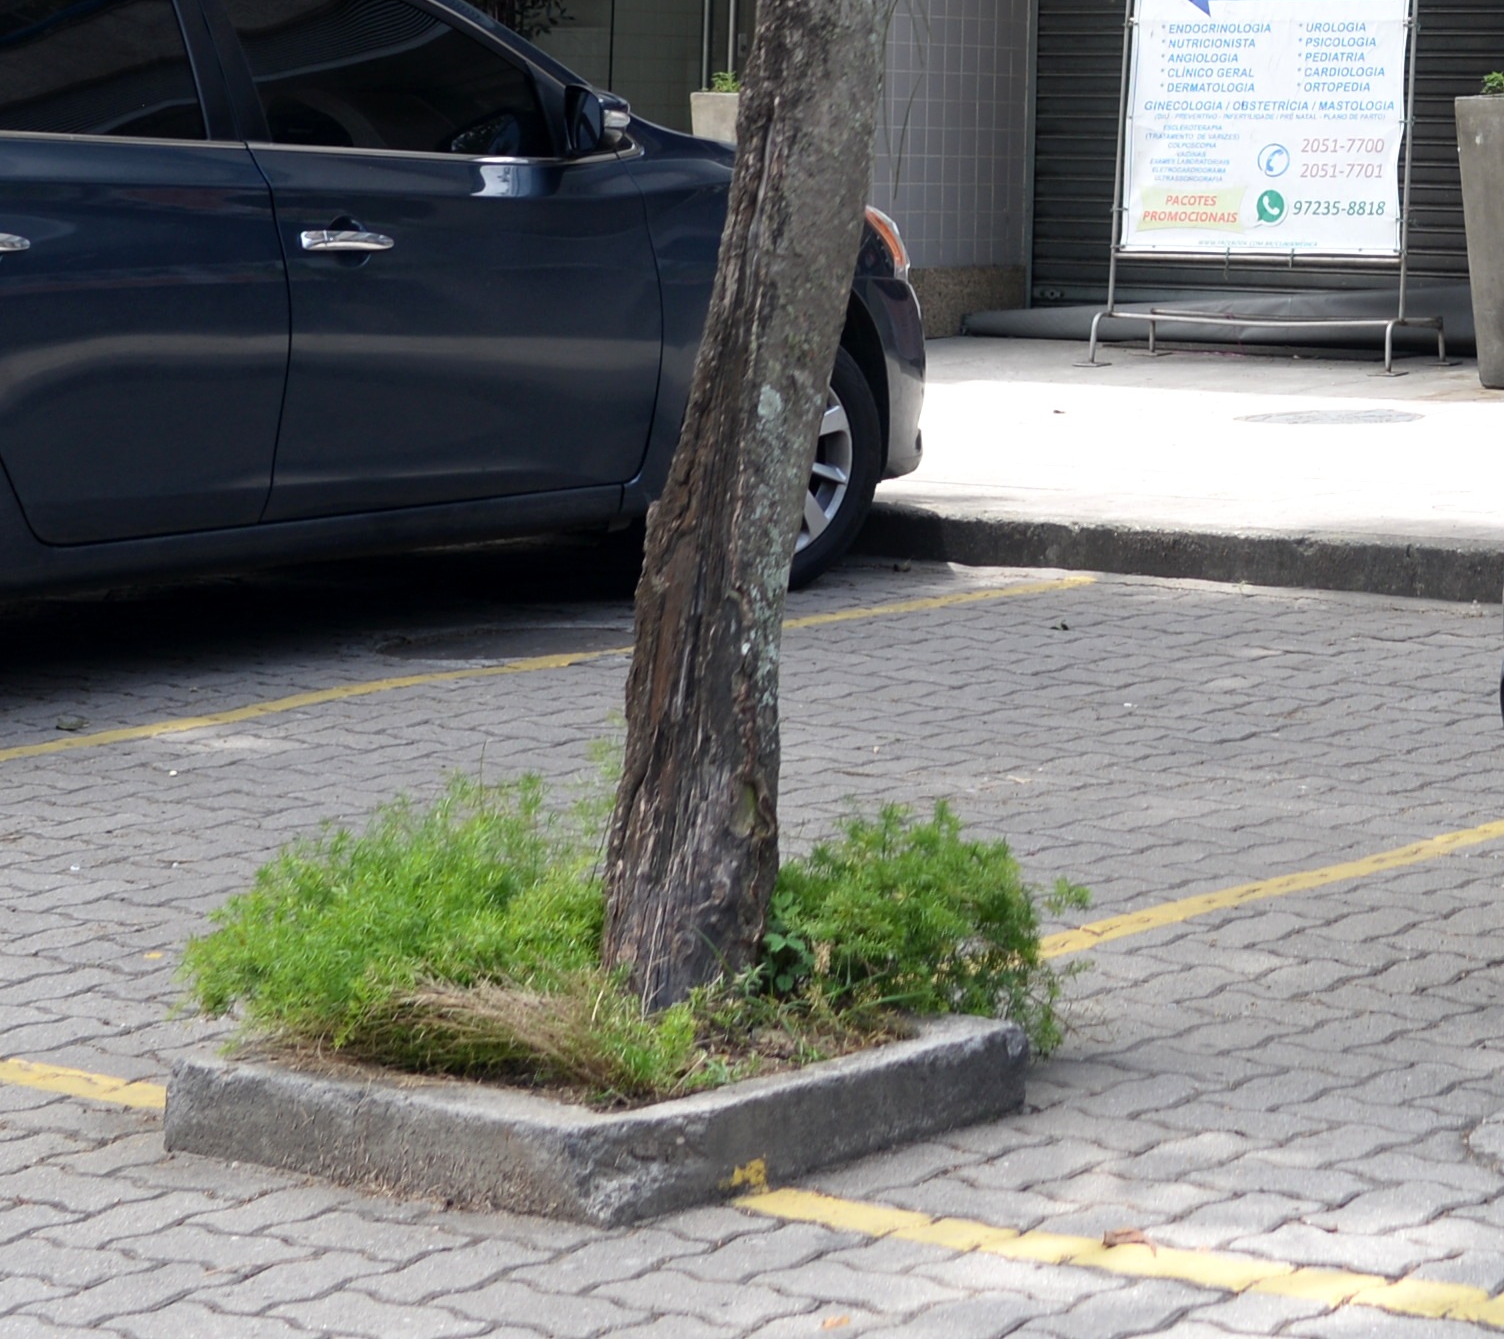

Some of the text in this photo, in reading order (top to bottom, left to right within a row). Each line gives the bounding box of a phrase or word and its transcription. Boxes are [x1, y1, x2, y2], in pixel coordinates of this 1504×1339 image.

[1168, 23, 1272, 34] ENDOCRINOLOGIA
[1305, 22, 1367, 33] UROLOGIA
[1168, 37, 1256, 48] NUTRICIONISTA
[1305, 37, 1377, 47] PSICOLOGIA
[1167, 53, 1239, 63] ANGIOLOGIA
[1304, 52, 1366, 62] PEDIATRIA
[1167, 66, 1255, 78] CLÍNICO GERAL
[1303, 66, 1386, 77] CARDIOLOGIA
[1166, 82, 1255, 93] DERMATOLOGIA
[1303, 82, 1371, 92] ORTOPEDIA
[1144, 98, 1395, 111] GINECOLOGIA OBSTETRÍCIA MASTOLOGIA
[1300, 138, 1385, 154] 2051-7700
[1299, 163, 1384, 179] 2051-7701
[1165, 195, 1218, 206] PACOTES
[1292, 200, 1386, 216] 97235-8818
[1142, 210, 1238, 223] PROMOCIONAIS
